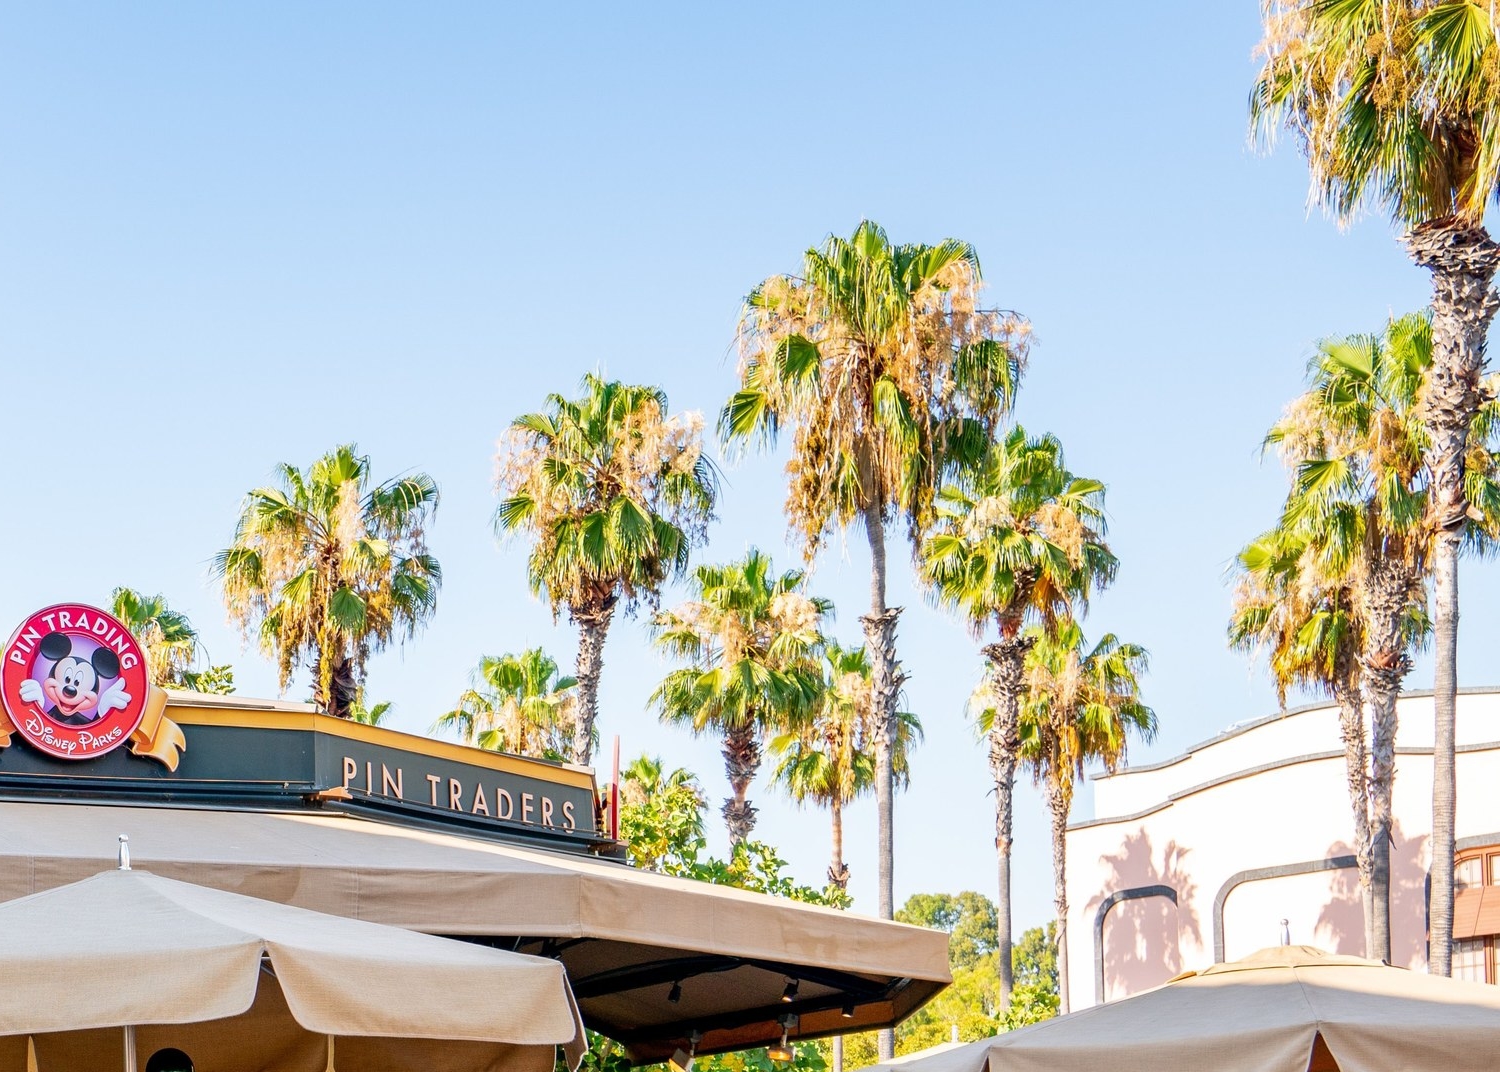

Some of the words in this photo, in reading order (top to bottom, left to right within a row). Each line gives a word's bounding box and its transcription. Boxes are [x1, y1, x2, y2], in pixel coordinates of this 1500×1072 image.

[10, 626, 43, 666] PIN
[41, 611, 138, 670] TRADING
[342, 757, 403, 799] PIN
[426, 774, 576, 834] TRADERS
